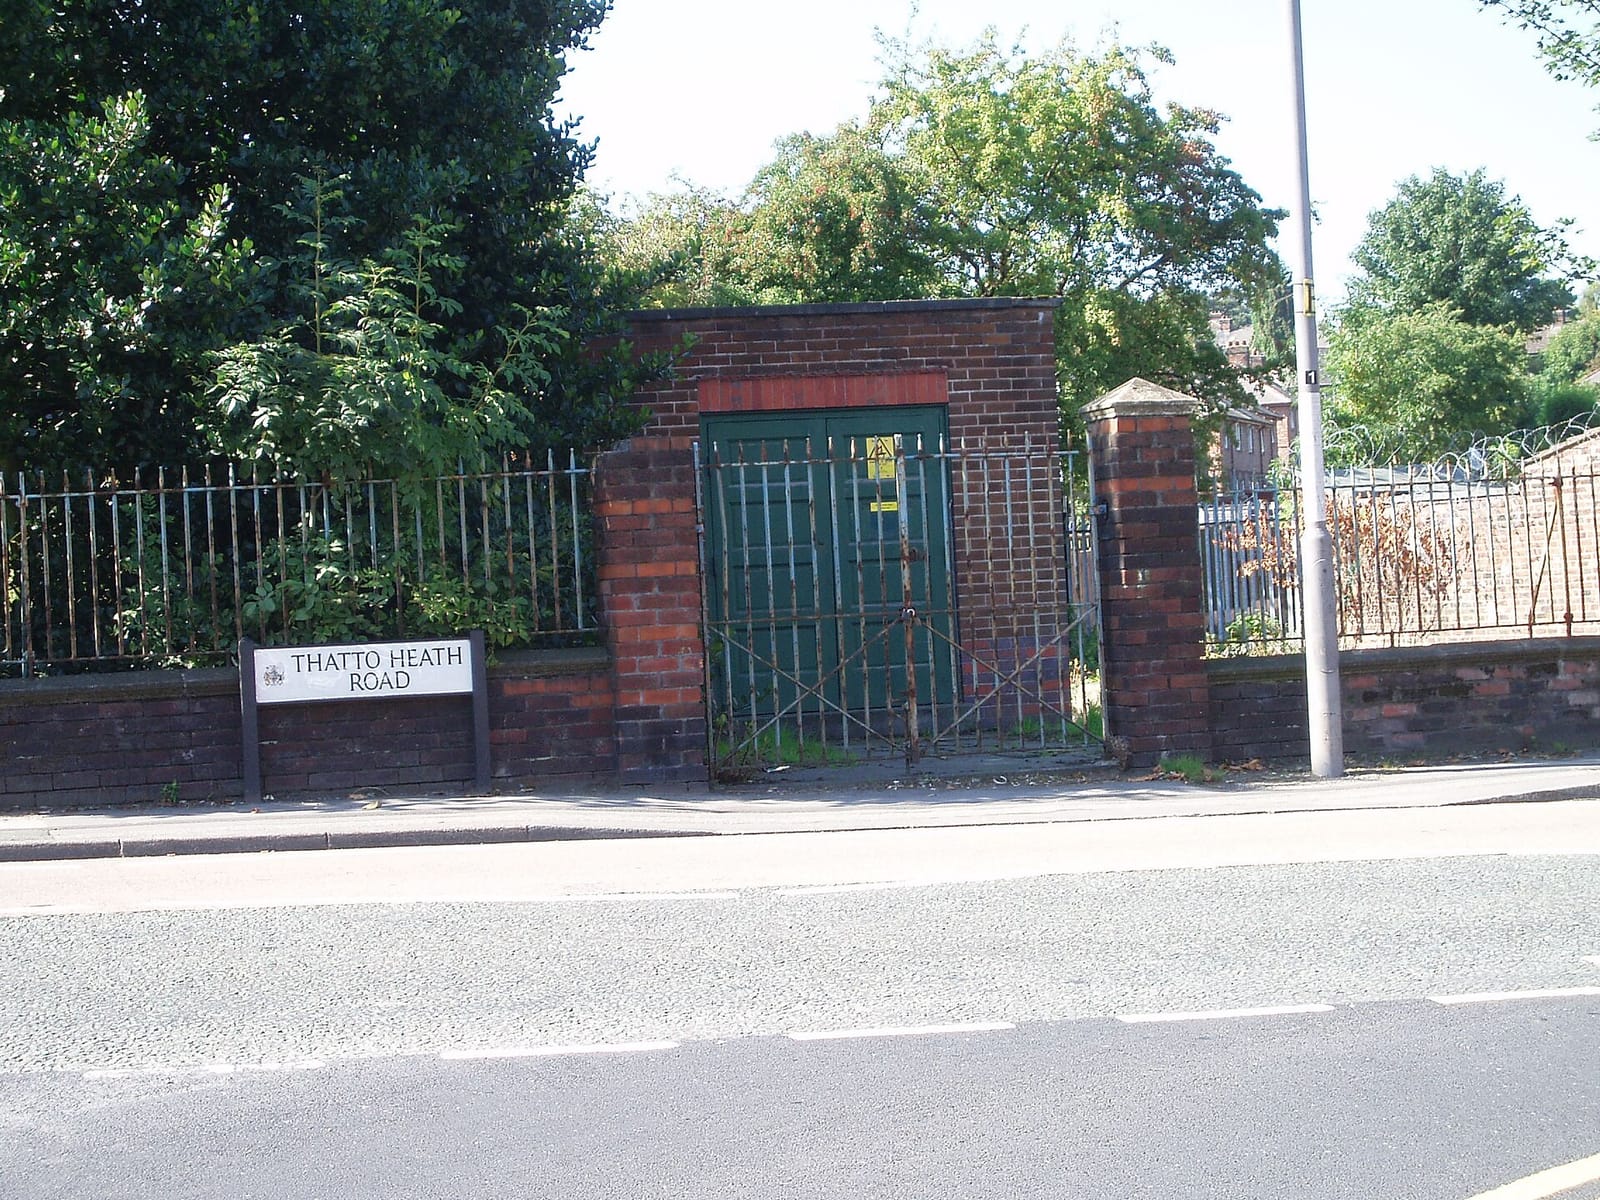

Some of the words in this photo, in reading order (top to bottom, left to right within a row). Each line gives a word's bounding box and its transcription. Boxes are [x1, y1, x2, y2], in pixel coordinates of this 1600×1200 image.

[291, 650, 380, 673] THATTO
[390, 647, 463, 668] HEATH
[350, 671, 410, 691] ROAD
